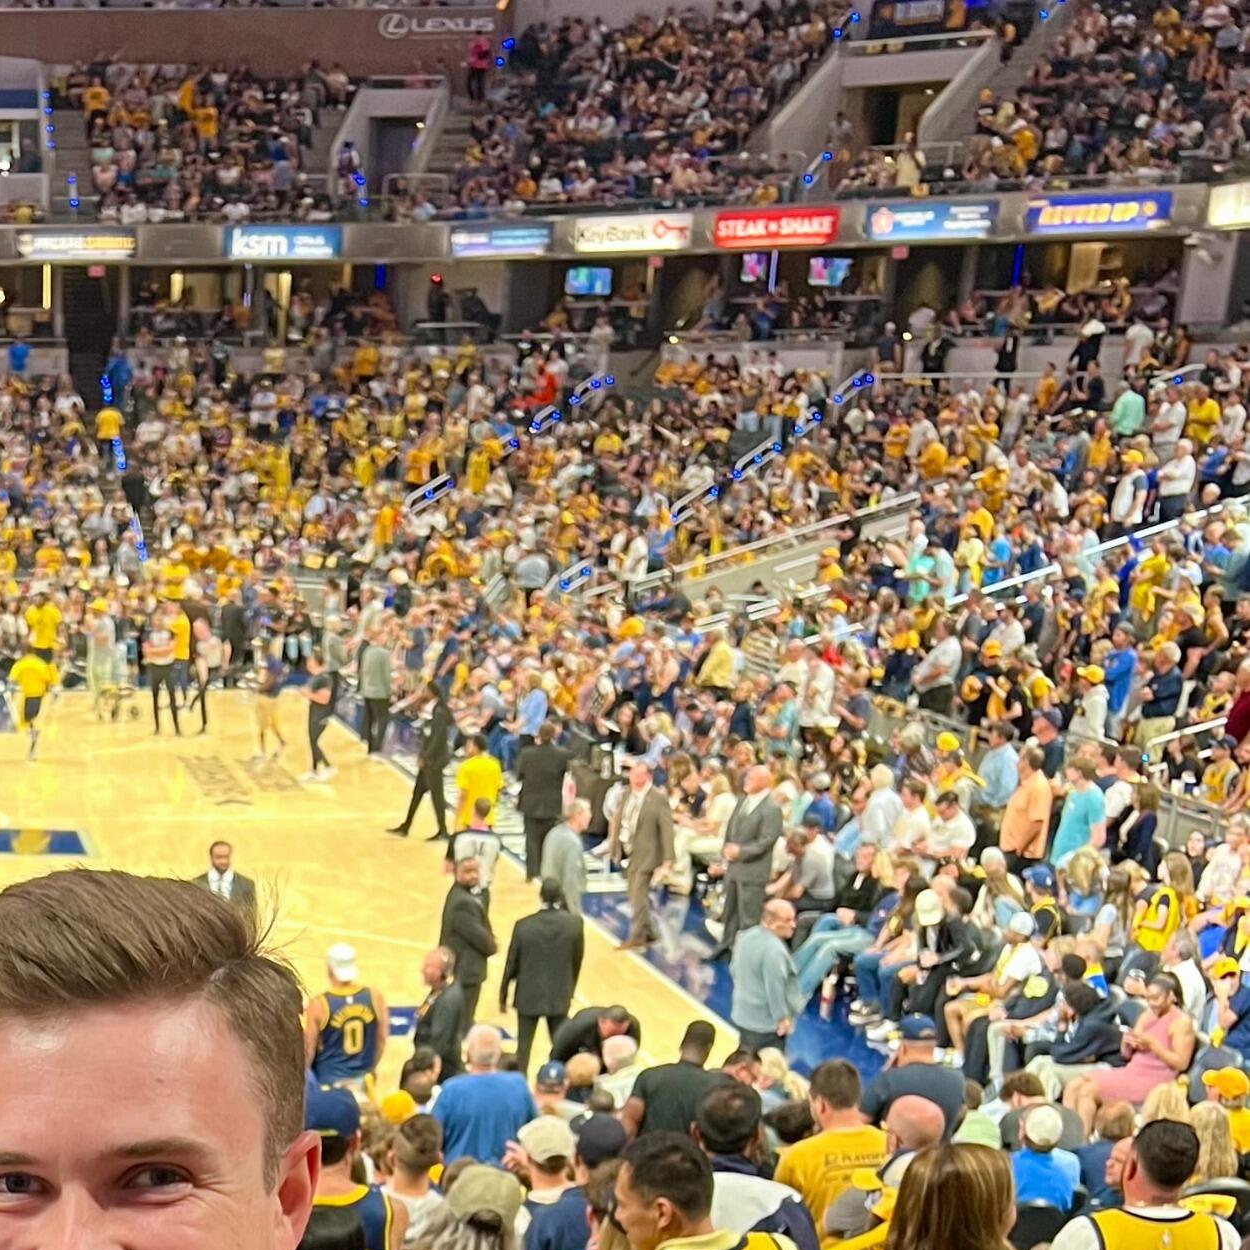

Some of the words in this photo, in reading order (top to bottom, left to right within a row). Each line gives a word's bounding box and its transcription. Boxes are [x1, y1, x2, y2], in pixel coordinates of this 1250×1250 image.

[411, 18, 495, 32] LEXUS
[577, 225, 648, 244] KeyBank
[717, 218, 766, 237] STEAK
[779, 216, 834, 234] SHAKE
[232, 229, 288, 257] ksm
[343, 1019, 364, 1055] 0
